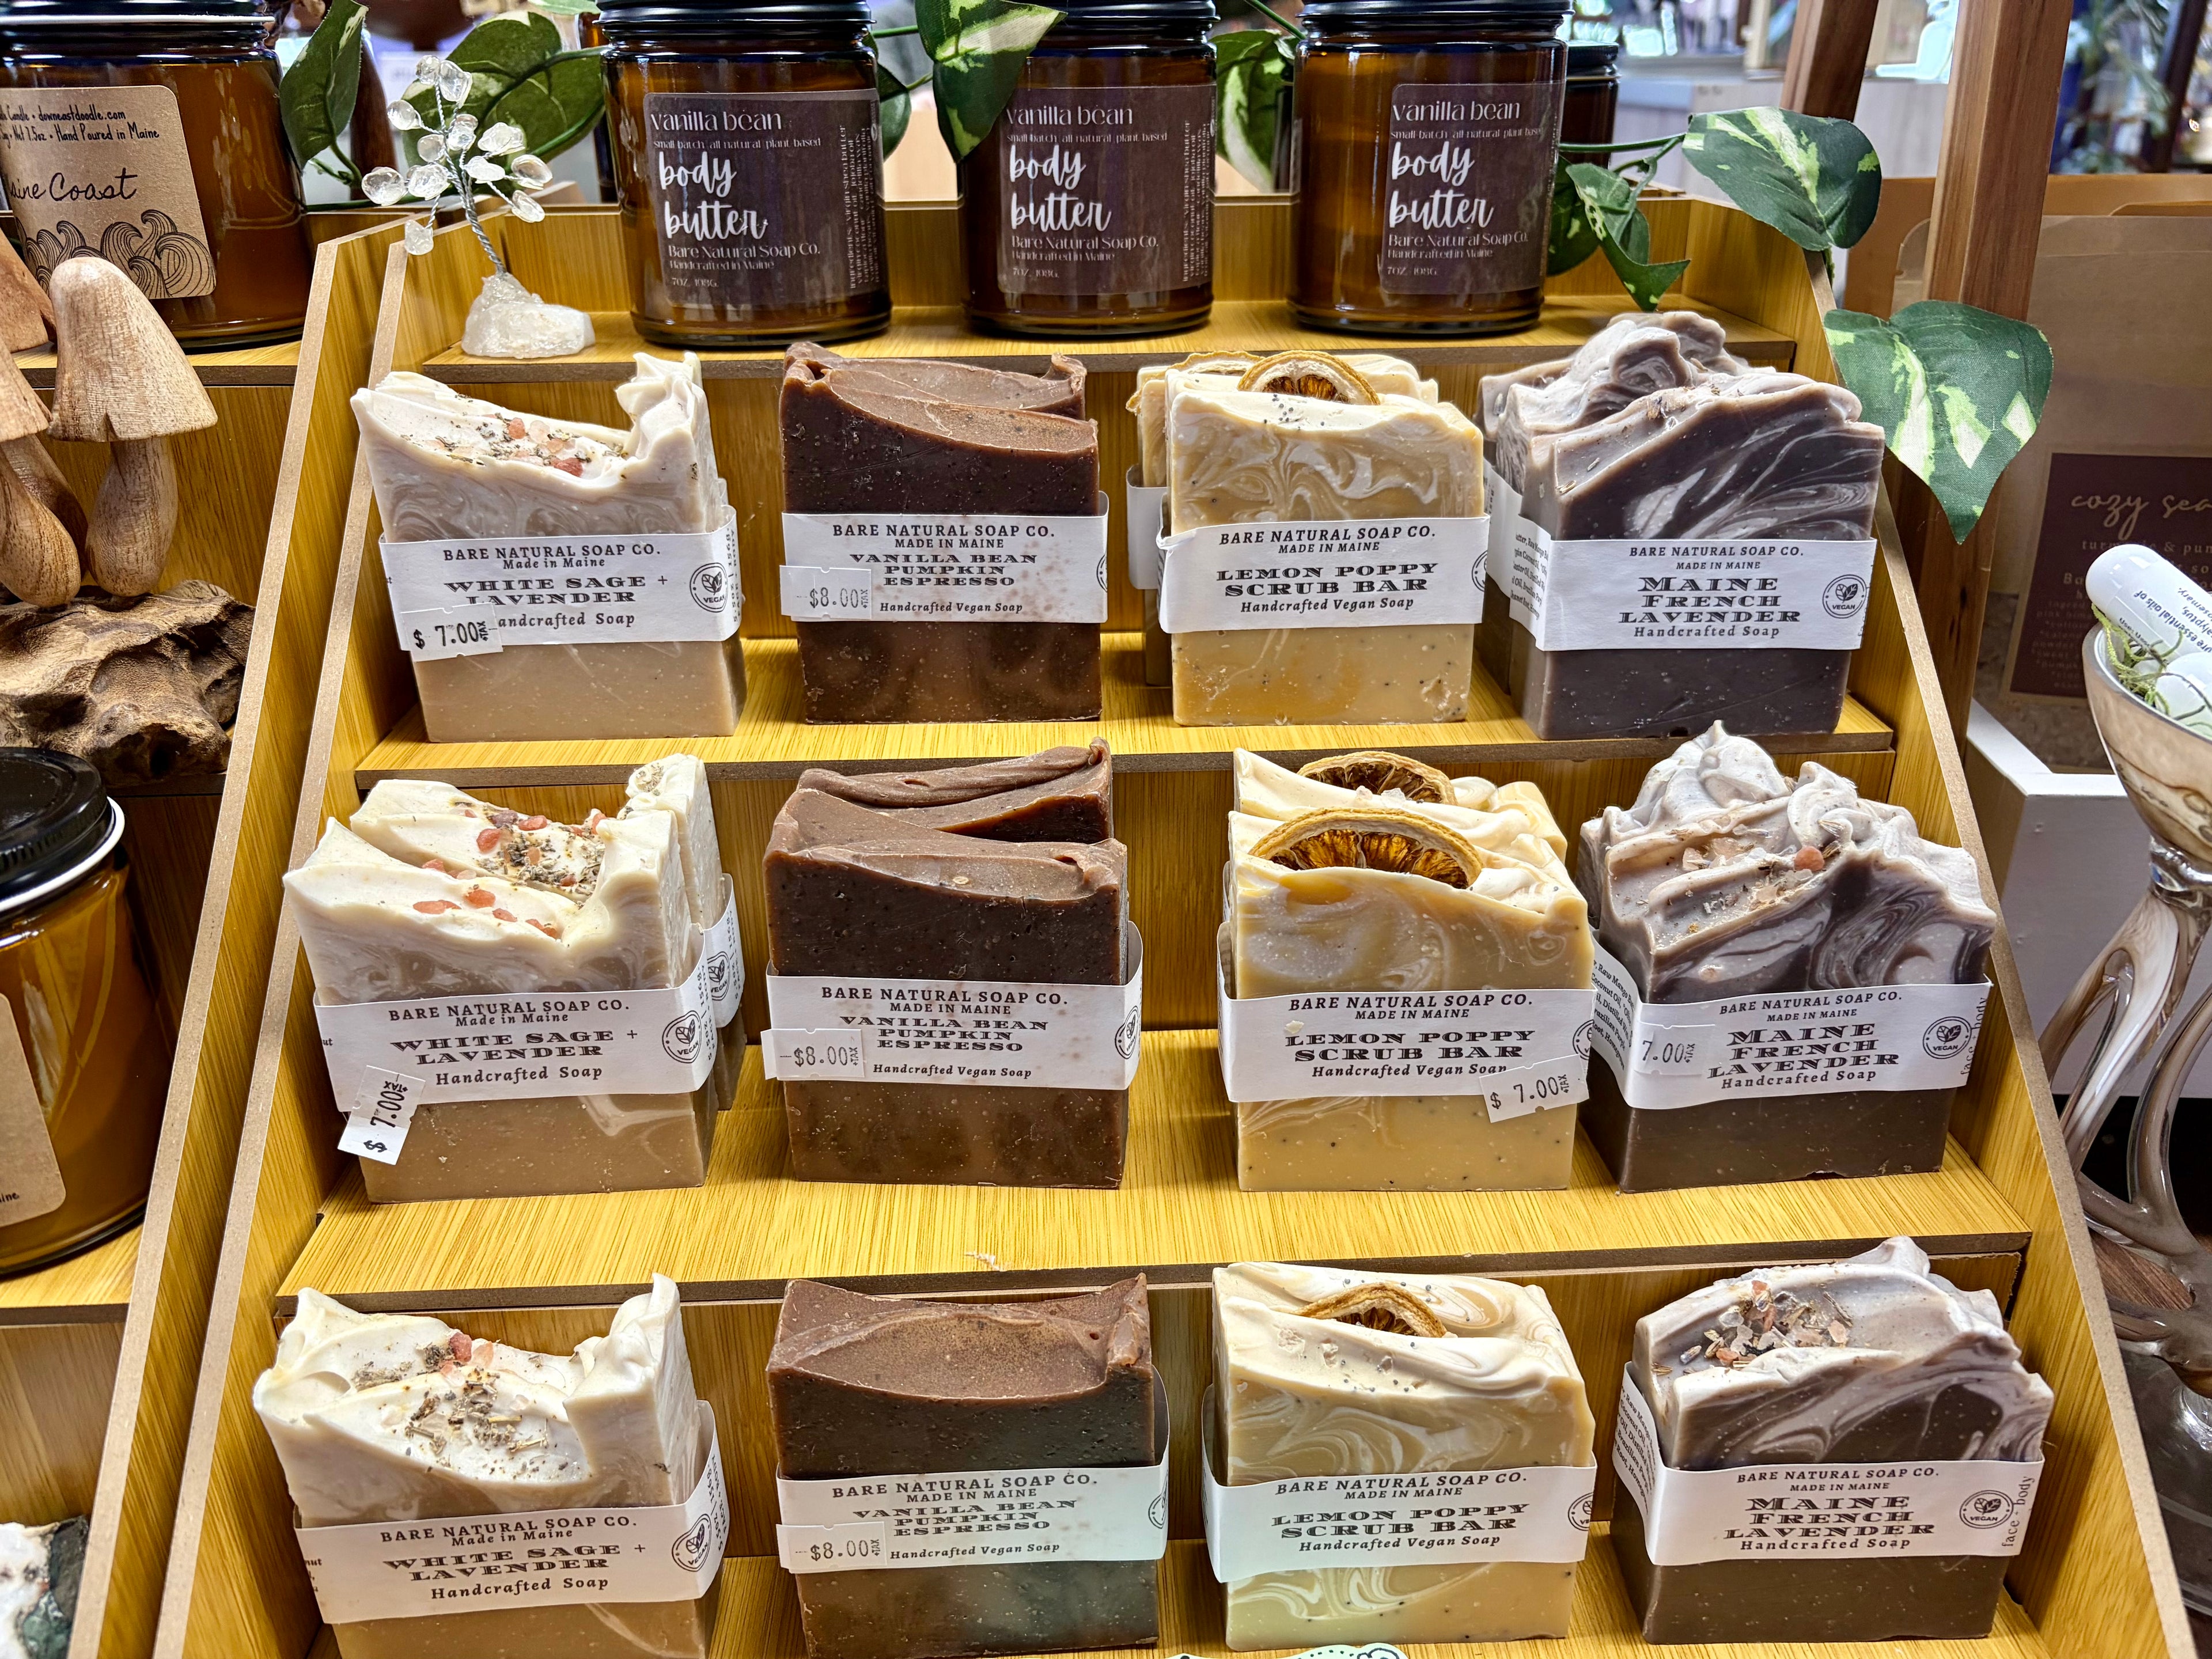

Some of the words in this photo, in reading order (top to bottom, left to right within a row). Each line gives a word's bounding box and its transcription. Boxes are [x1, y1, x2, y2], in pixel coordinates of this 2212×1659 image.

[39, 104, 126, 121] downeastdoodle.com
[1006, 105, 1071, 125] vanilla
[1078, 106, 1132, 125] bean
[1393, 101, 1464, 121] vanilla
[1471, 102, 1520, 121] bean
[651, 111, 718, 131] vanilla
[724, 111, 782, 131] bean
[54, 124, 79, 141] Hand
[80, 123, 113, 141] Poured
[116, 130, 125, 139] in
[127, 122, 160, 141] Maine
[1142, 133, 1167, 141] based
[1010, 145, 1086, 190] body
[1392, 141, 1475, 186] body
[659, 151, 736, 197] body
[10, 179, 46, 199] aine
[50, 168, 138, 201] Coast
[1011, 192, 1111, 232] butter
[1389, 190, 1494, 230] butter
[664, 201, 768, 241] butter
[1389, 234, 1423, 247] Bare
[1426, 233, 1479, 246] Natural
[1483, 232, 1512, 246] Soap
[1514, 231, 1528, 243] Co.
[668, 245, 699, 258] Bare
[702, 245, 756, 258] Natural
[759, 244, 796, 258] Soap
[800, 243, 820, 256] Co.
[2071, 494, 2149, 540] cozy
[443, 548, 488, 560] BARE
[495, 546, 575, 559] NATURAL
[582, 544, 624, 556] SOAP
[632, 544, 660, 555] CO.
[1279, 544, 1315, 553] MADE
[1319, 544, 1333, 552] IN
[1338, 541, 1380, 552] MAINE
[1630, 547, 1665, 556] BARE
[1672, 547, 1735, 556] NATURAL
[1740, 547, 1775, 555] SOAP
[1781, 547, 1803, 555] CO.
[850, 554, 960, 563] VANILLA
[971, 555, 1036, 563] BEAN
[885, 566, 1005, 574] PUMPKIN
[1217, 567, 1323, 581] LEMON
[1335, 563, 1437, 577] POPPY
[444, 579, 554, 592] WHITE
[566, 577, 645, 588] SAGE
[658, 576, 667, 585] +
[884, 577, 1014, 585] ESPRESSO
[1225, 582, 1339, 596] SCRUB
[1353, 579, 1427, 593] BAR
[1638, 577, 1778, 592] MAINE
[880, 602, 952, 614] Handcrafted
[956, 603, 990, 613] Vegan
[995, 603, 1022, 613] Soap
[1642, 595, 1781, 607] FRENCH
[498, 612, 585, 629] andcrafted
[596, 613, 634, 627] Soap
[1619, 611, 1800, 623] LAVENDER
[2158, 605, 2198, 641] essential
[434, 623, 478, 646] 7.00
[822, 987, 872, 999] BARE
[881, 989, 971, 1002] NATURAL
[979, 991, 1028, 1003] SOAP
[1036, 993, 1067, 1004] CO.
[1720, 1001, 1756, 1014] BARE
[1762, 997, 1830, 1009] NATURAL
[1835, 993, 1873, 1004] SOAP
[1878, 991, 1901, 1001] CO.
[456, 1016, 495, 1027] Made
[502, 1013, 515, 1024] in
[522, 1012, 568, 1022] Maine
[840, 1017, 962, 1027] VANILLA
[974, 1020, 1048, 1030] BEAN
[391, 1035, 513, 1051] WHITE
[526, 1031, 613, 1043] SAGE
[627, 1030, 637, 1039] +
[879, 1029, 1012, 1040] PUMPKIN
[1286, 1033, 1406, 1046] LEMON
[1419, 1031, 1535, 1043] POPPY
[1727, 1024, 1876, 1046] MAINE
[677, 1041, 698, 1055] VEGAN
[878, 1040, 1022, 1051] ESPRESSO
[1295, 1048, 1423, 1062] SCRUB
[1438, 1046, 1522, 1058] BAR
[1643, 1040, 1684, 1063] 7.00
[1729, 1040, 1878, 1060] FRENCH
[416, 1046, 602, 1065] LAVENDER
[1312, 1064, 1410, 1078] Handcrafted
[1416, 1065, 1463, 1078] Vegan
[1709, 1054, 1899, 1081] LAVENDER
[1722, 1071, 1828, 1089] Handcrafted
[1836, 1071, 1876, 1081] Soap
[1513, 1077, 1559, 1103] 7.00
[370, 1091, 404, 1127] 7.00
[1276, 1481, 1328, 1494] BARE
[1336, 1477, 1429, 1490] NATURAL
[1437, 1475, 1488, 1486] SOAP
[1495, 1472, 1526, 1483] CO.
[907, 1493, 952, 1502] MADE
[984, 1488, 1036, 1498] MAINE
[1745, 1497, 1909, 1511] MAINE
[853, 1505, 986, 1520] VANILLA
[998, 1501, 1076, 1510] BEAN
[1272, 1511, 1396, 1526] LEMON
[1410, 1504, 1528, 1520] POPPY
[1750, 1512, 1914, 1524] FRENCH
[2002, 1521, 2020, 1546] face
[2013, 1476, 2035, 1505] body
[894, 1512, 1039, 1531] PUMPKIN
[895, 1518, 1050, 1536] ESPRESSO
[1281, 1523, 1414, 1539] SCRUB
[1430, 1518, 1516, 1532] BAR
[1725, 1523, 1934, 1539] LAVENDER
[1300, 1538, 1400, 1551] Handcrafted
[1408, 1538, 1455, 1549] Vegan
[1461, 1536, 1499, 1546] Soap
[384, 1551, 513, 1569] WHITE
[528, 1546, 620, 1558] SAGE
[635, 1544, 645, 1552] +
[410, 1555, 608, 1581] LAVENDER
